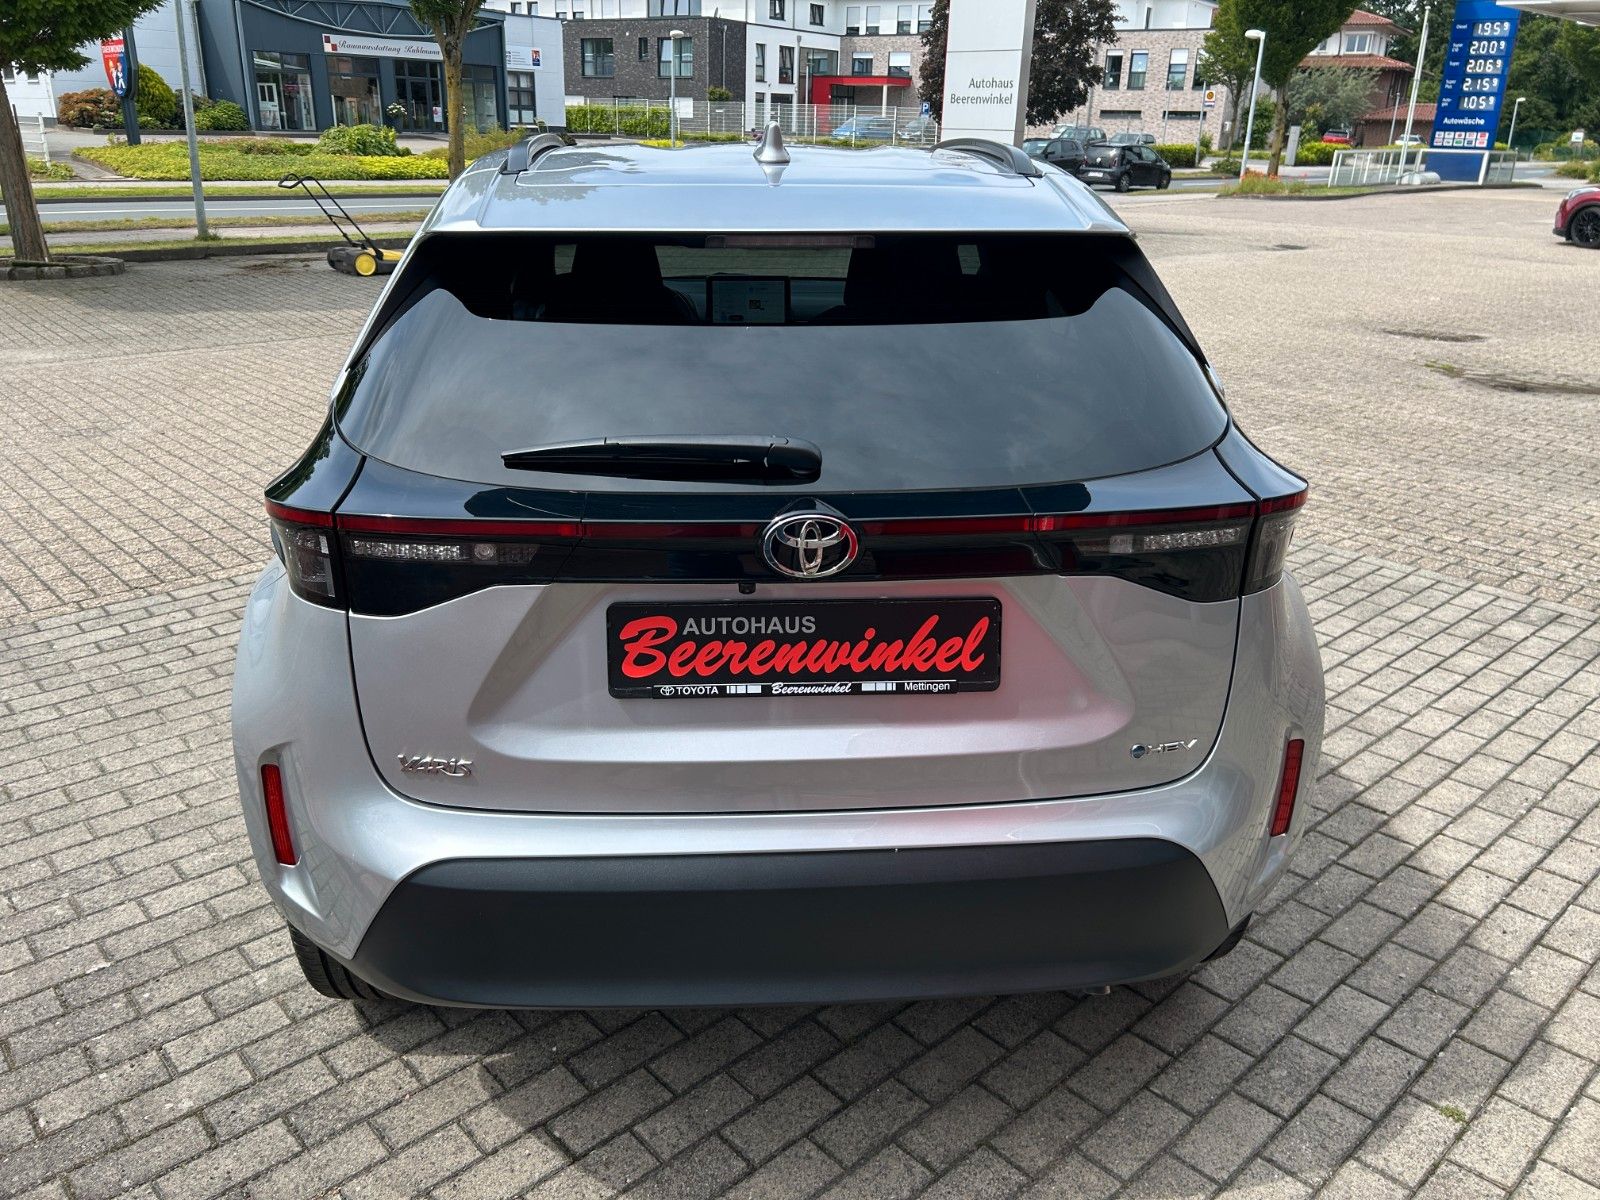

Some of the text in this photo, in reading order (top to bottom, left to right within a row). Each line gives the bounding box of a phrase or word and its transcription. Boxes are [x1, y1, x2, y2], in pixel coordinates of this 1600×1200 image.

[968, 77, 1014, 89] Autohaus
[950, 93, 1013, 105] Beerenwinkel
[1443, 116, 1485, 125] Autowäsche
[682, 615, 816, 636] AUTOHAUS
[619, 614, 990, 679] Beerenwinkel
[675, 682, 950, 695] TOYOTA Beerenwinkel Mettingen
[396, 753, 474, 777] YARIS
